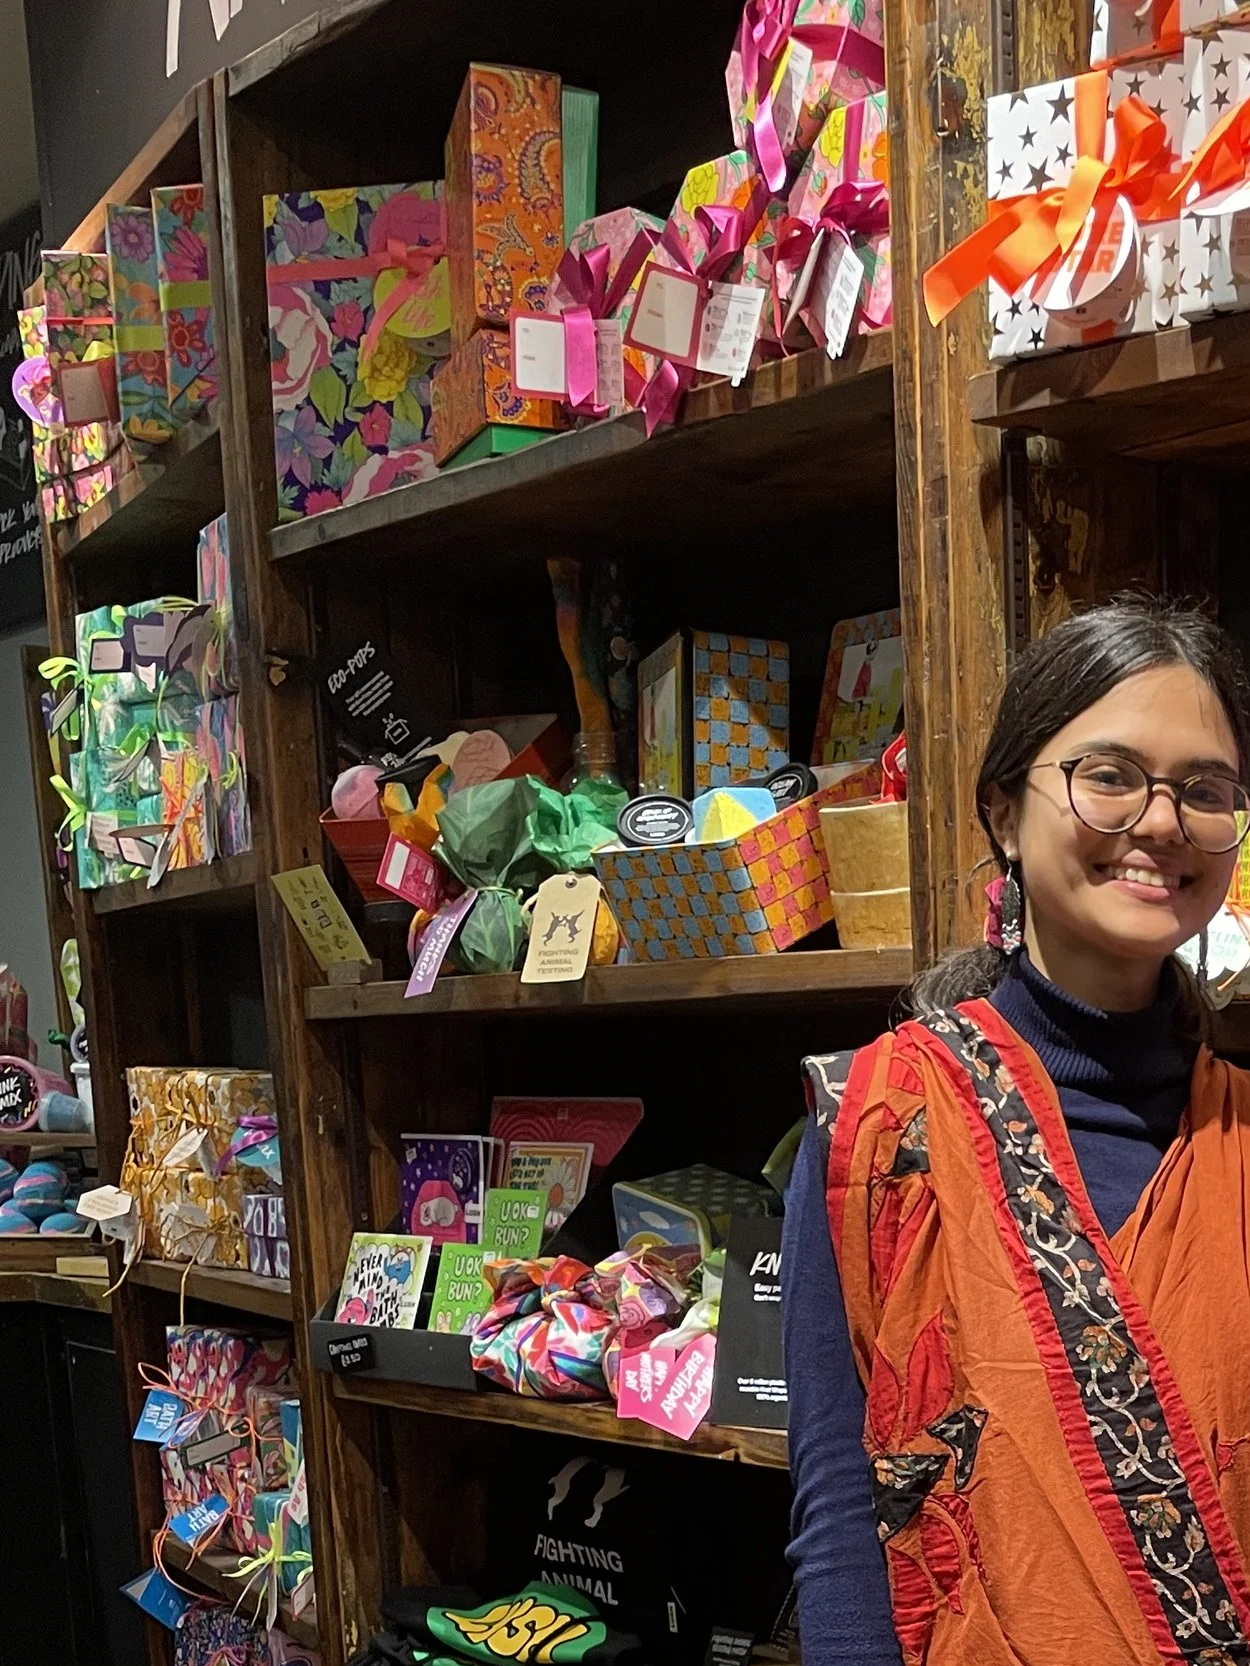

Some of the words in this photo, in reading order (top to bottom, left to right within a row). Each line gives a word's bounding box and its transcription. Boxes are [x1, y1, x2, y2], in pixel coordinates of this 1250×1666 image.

[327, 641, 376, 694] ECO-POPS
[501, 1202, 511, 1222] U
[513, 1202, 528, 1221] OK
[495, 1226, 530, 1249] BUN?
[353, 1252, 383, 1287] NEVER
[358, 1271, 383, 1295] MIND
[454, 1254, 465, 1277] U
[466, 1255, 482, 1277] OK
[370, 1289, 398, 1325] BATH
[447, 1281, 483, 1304] BUN?
[660, 1350, 705, 1421] BIRTHDAY
[534, 1533, 624, 1574] FIGHTING
[541, 1570, 619, 1606] ANIMAL
